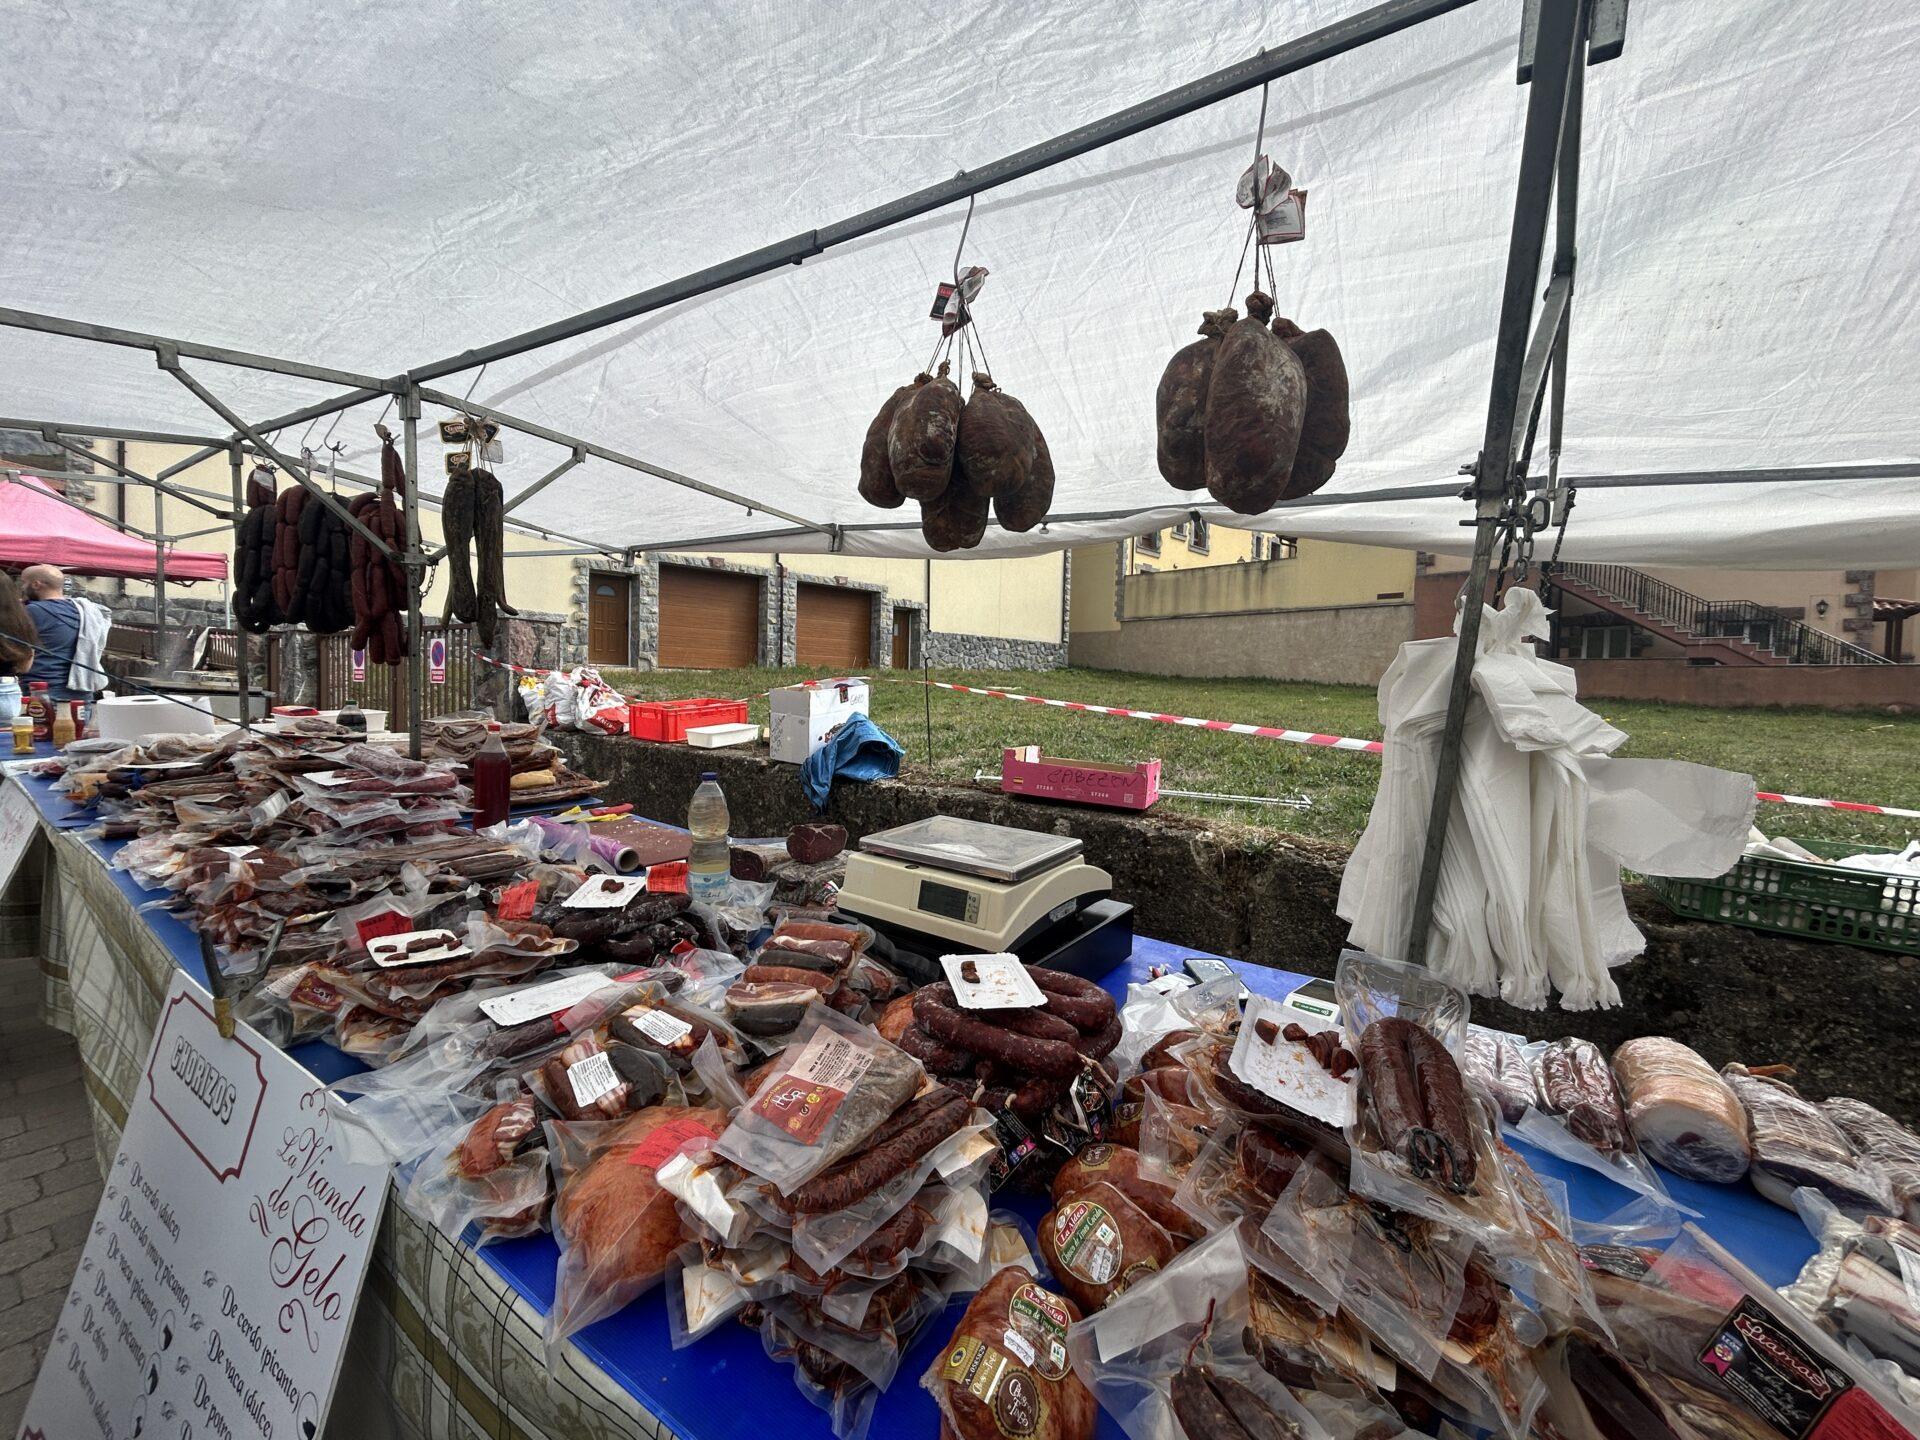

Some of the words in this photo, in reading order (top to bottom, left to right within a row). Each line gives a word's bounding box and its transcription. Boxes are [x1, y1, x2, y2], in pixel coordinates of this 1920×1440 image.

[171, 1035, 236, 1125] CHORIZOS
[130, 1161, 143, 1187] De
[277, 1126, 299, 1169] La
[297, 1127, 366, 1238] Vianda
[120, 1195, 132, 1222] De
[268, 1175, 293, 1219] de
[107, 1232, 119, 1260] De
[269, 1194, 347, 1322] Gelo
[94, 1268, 107, 1297] De
[82, 1304, 94, 1334] De
[221, 1285, 238, 1318] De
[237, 1312, 262, 1351] cerdo
[68, 1342, 81, 1373] De
[208, 1329, 225, 1364] De
[225, 1358, 244, 1397] vaca
[194, 1374, 210, 1410] De
